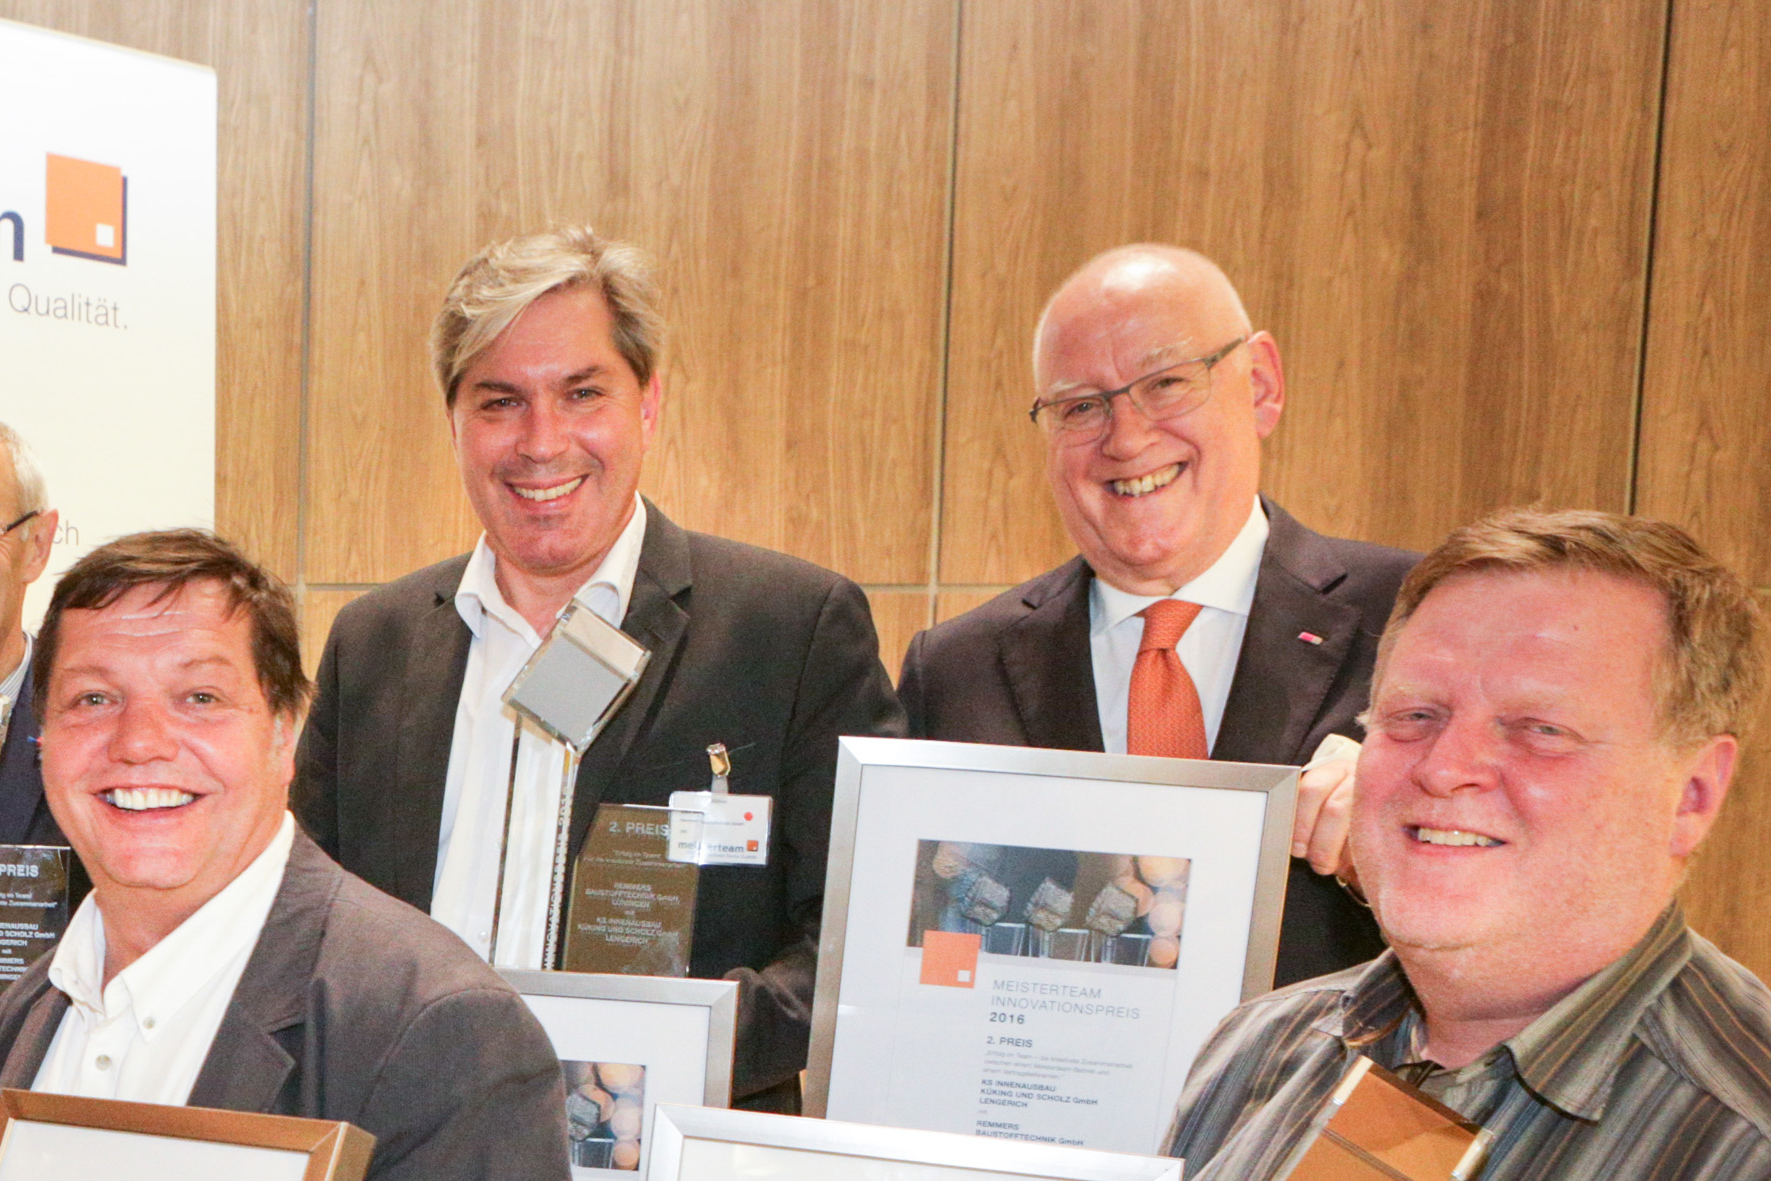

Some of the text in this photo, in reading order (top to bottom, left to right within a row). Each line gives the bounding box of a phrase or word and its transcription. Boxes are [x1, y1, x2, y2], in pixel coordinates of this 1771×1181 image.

[8, 283, 129, 331] Qualität.
[608, 821, 621, 833] 2.
[625, 821, 670, 837] PREIS
[992, 979, 1102, 999] MEISTERTEAM
[991, 995, 1141, 1020] INNOVATIONSPREIS
[989, 1012, 1026, 1025] 2016
[986, 1035, 1033, 1048] 2. PREIS
[995, 1079, 1057, 1092] INNENAUSBAU
[978, 1097, 1028, 1108] LENGERICH
[1015, 1091, 1035, 1100] UND
[1036, 1093, 1071, 1103] SCHOLZ
[1072, 1096, 1099, 1106] GmbH
[975, 1119, 1020, 1131] REMMERS
[1058, 1136, 1085, 1147] GmbH
